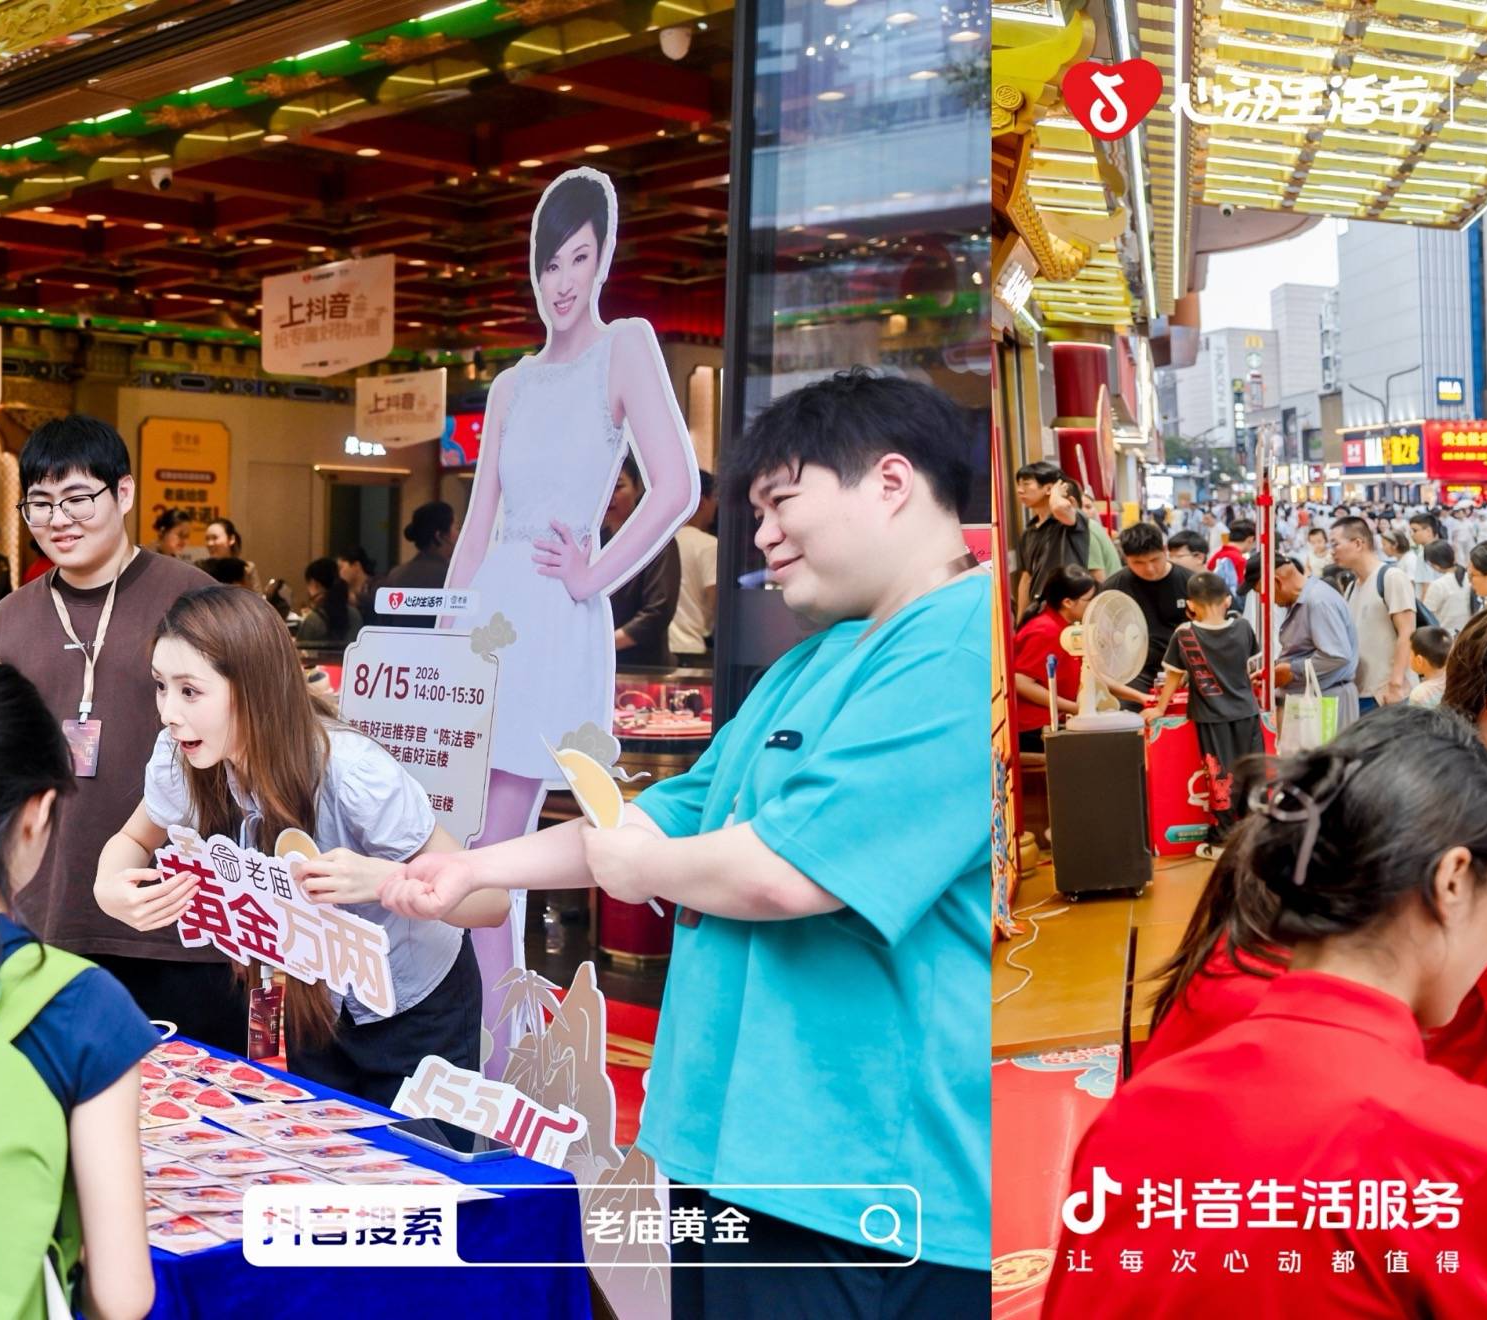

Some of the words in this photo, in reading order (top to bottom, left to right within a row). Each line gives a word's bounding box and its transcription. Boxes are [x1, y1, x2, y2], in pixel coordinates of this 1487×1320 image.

[354, 663, 410, 699] 8/15
[415, 667, 439, 680] 2026
[414, 684, 484, 705] 14:00-15:30
[245, 857, 292, 900] 老庙
[161, 854, 388, 1010] 黄金万两
